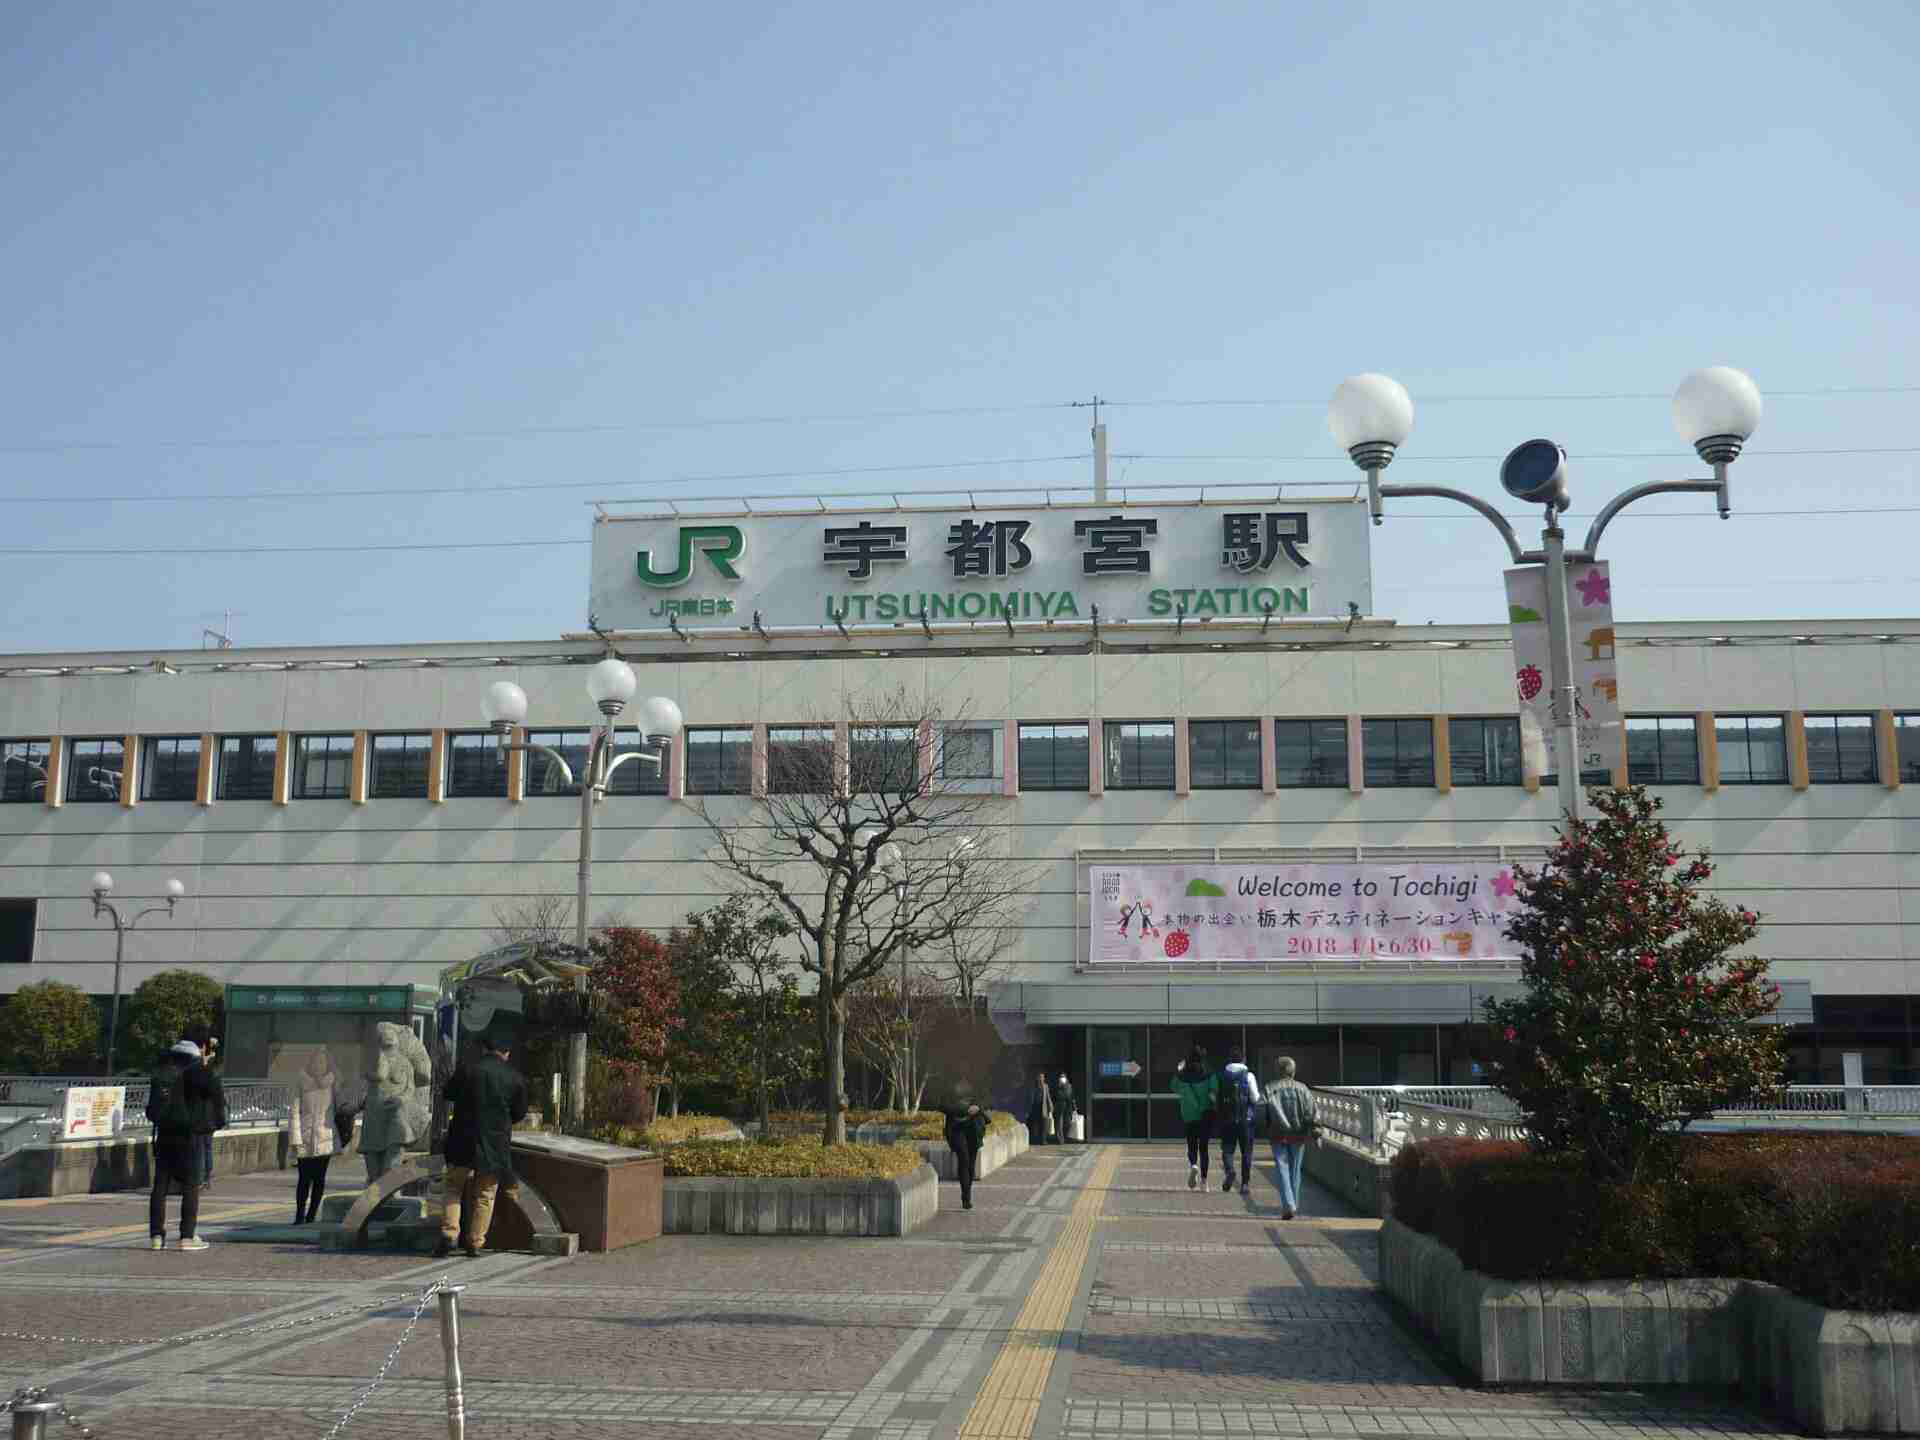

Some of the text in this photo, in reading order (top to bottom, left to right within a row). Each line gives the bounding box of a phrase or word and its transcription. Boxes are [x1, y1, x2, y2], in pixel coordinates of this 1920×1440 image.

[636, 525, 745, 587] JR
[823, 512, 1312, 578] 宇都宮駅
[825, 586, 1309, 621] UTSUNOMIYA STATION
[1237, 873, 1479, 902] Welcome to Tochigi
[1287, 935, 1337, 955] 2018
